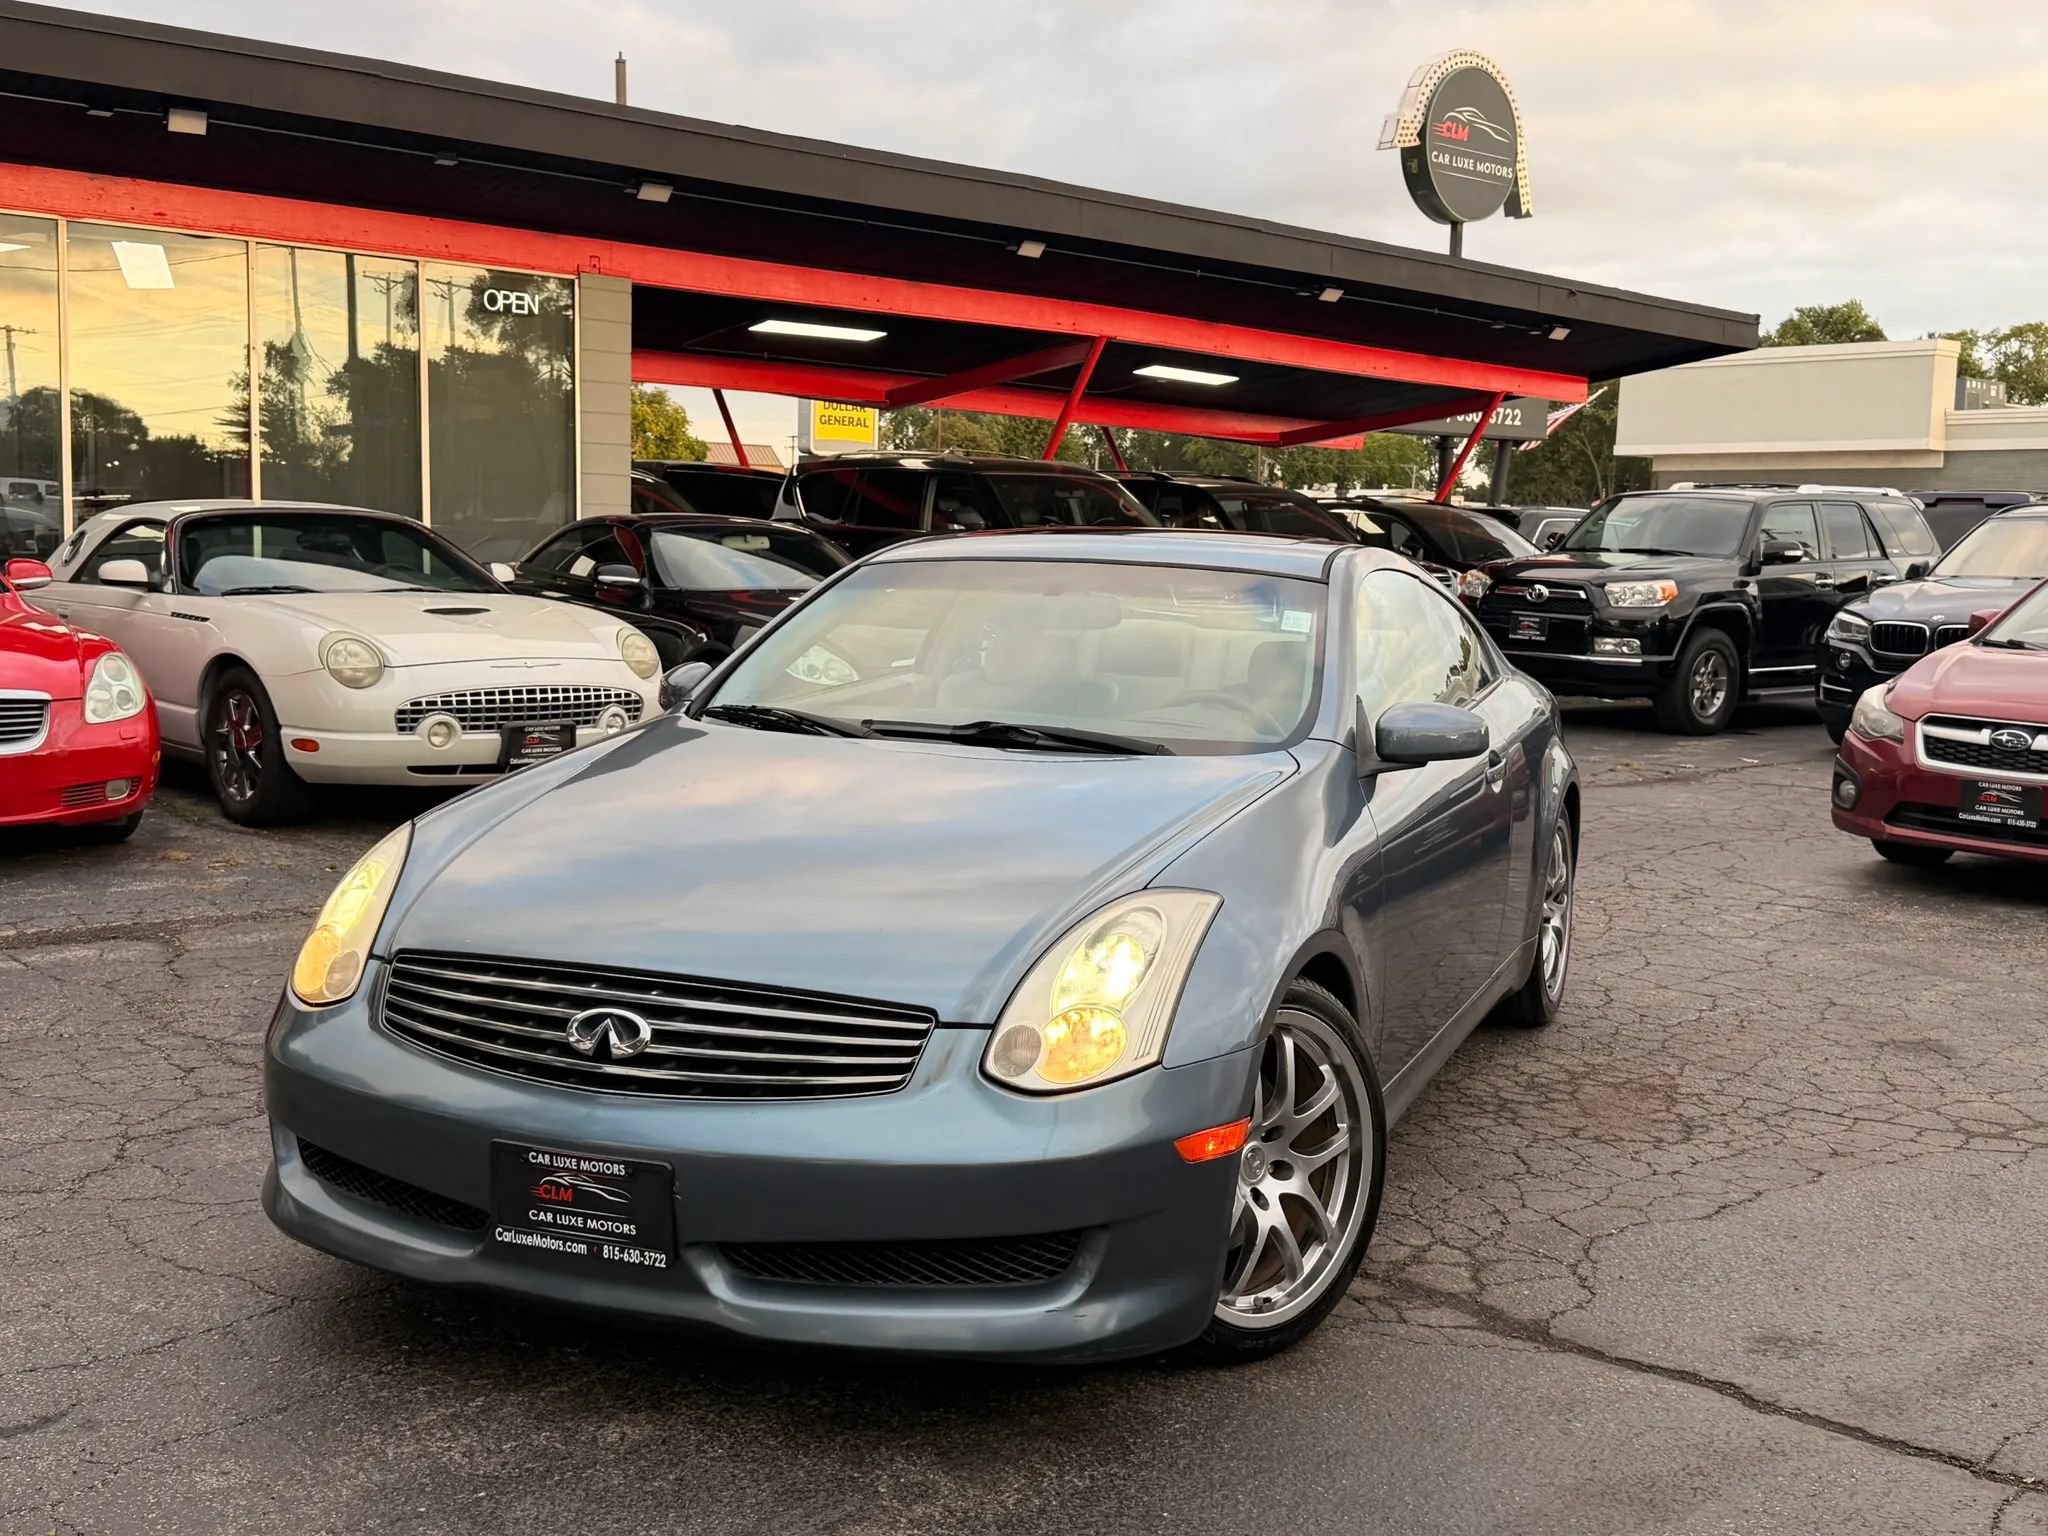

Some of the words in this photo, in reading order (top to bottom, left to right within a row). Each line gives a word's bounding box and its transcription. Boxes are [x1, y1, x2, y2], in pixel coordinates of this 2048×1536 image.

[1443, 121, 1470, 142] CLM
[1431, 151, 1450, 165] CAR
[1452, 155, 1475, 171] LUXE
[1476, 161, 1513, 179] MOTORS
[483, 289, 539, 315] OPEN
[819, 414, 870, 428] GENERAL
[2001, 807, 2024, 816] MOTORS
[528, 1151, 551, 1166] CAR
[552, 1155, 578, 1169] LUXE
[579, 1160, 626, 1176] MOTORS
[539, 1184, 574, 1203] CLM
[528, 1209, 554, 1223] CAR
[556, 1213, 584, 1228] LUXE
[586, 1219, 637, 1236] MOTORS
[495, 1227, 588, 1256] CarLuxeMotors.com
[602, 1245, 667, 1269] 815-630-3722
